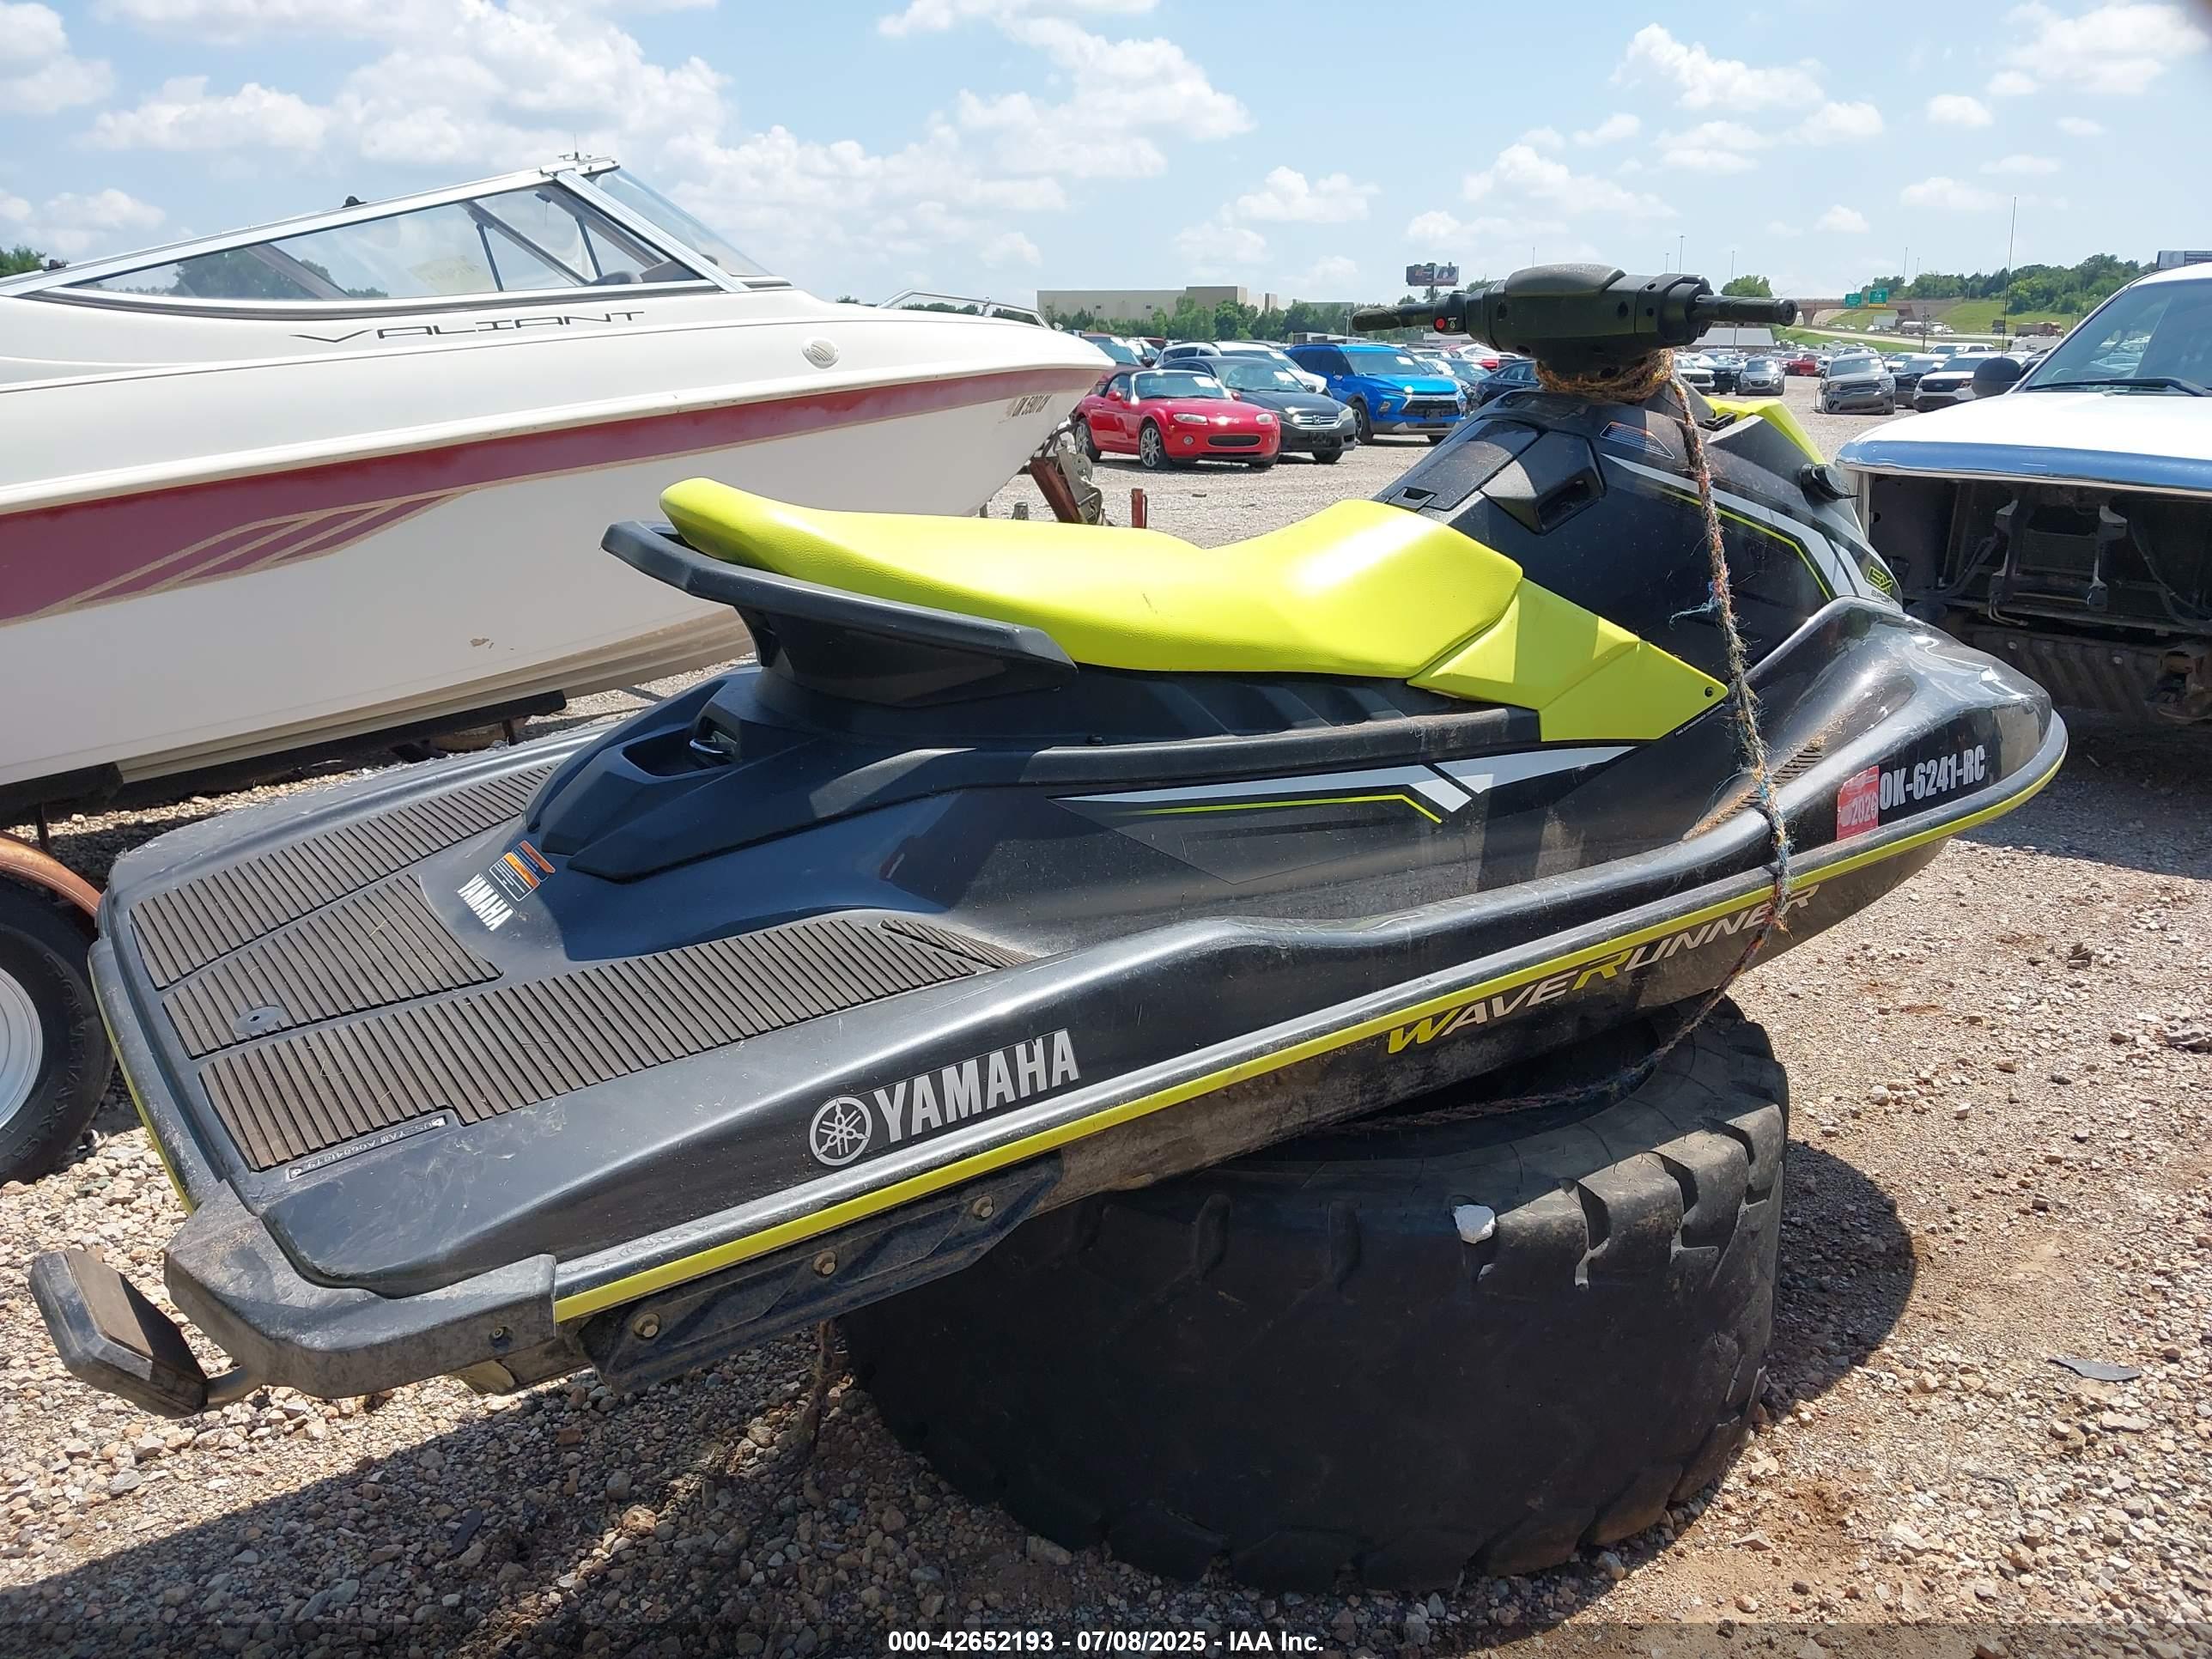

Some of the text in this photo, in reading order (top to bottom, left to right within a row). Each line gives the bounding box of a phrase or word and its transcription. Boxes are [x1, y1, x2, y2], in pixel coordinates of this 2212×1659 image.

[289, 310, 645, 343] VALIANT
[1865, 566, 1893, 595] EX
[1870, 589, 1894, 605] SPORT
[1879, 744, 1985, 811] OK-6241-RC
[457, 872, 514, 932] YAMAHA
[1388, 884, 1820, 1054] WAVERUNNER
[872, 1029, 1079, 1143] YAMAHA
